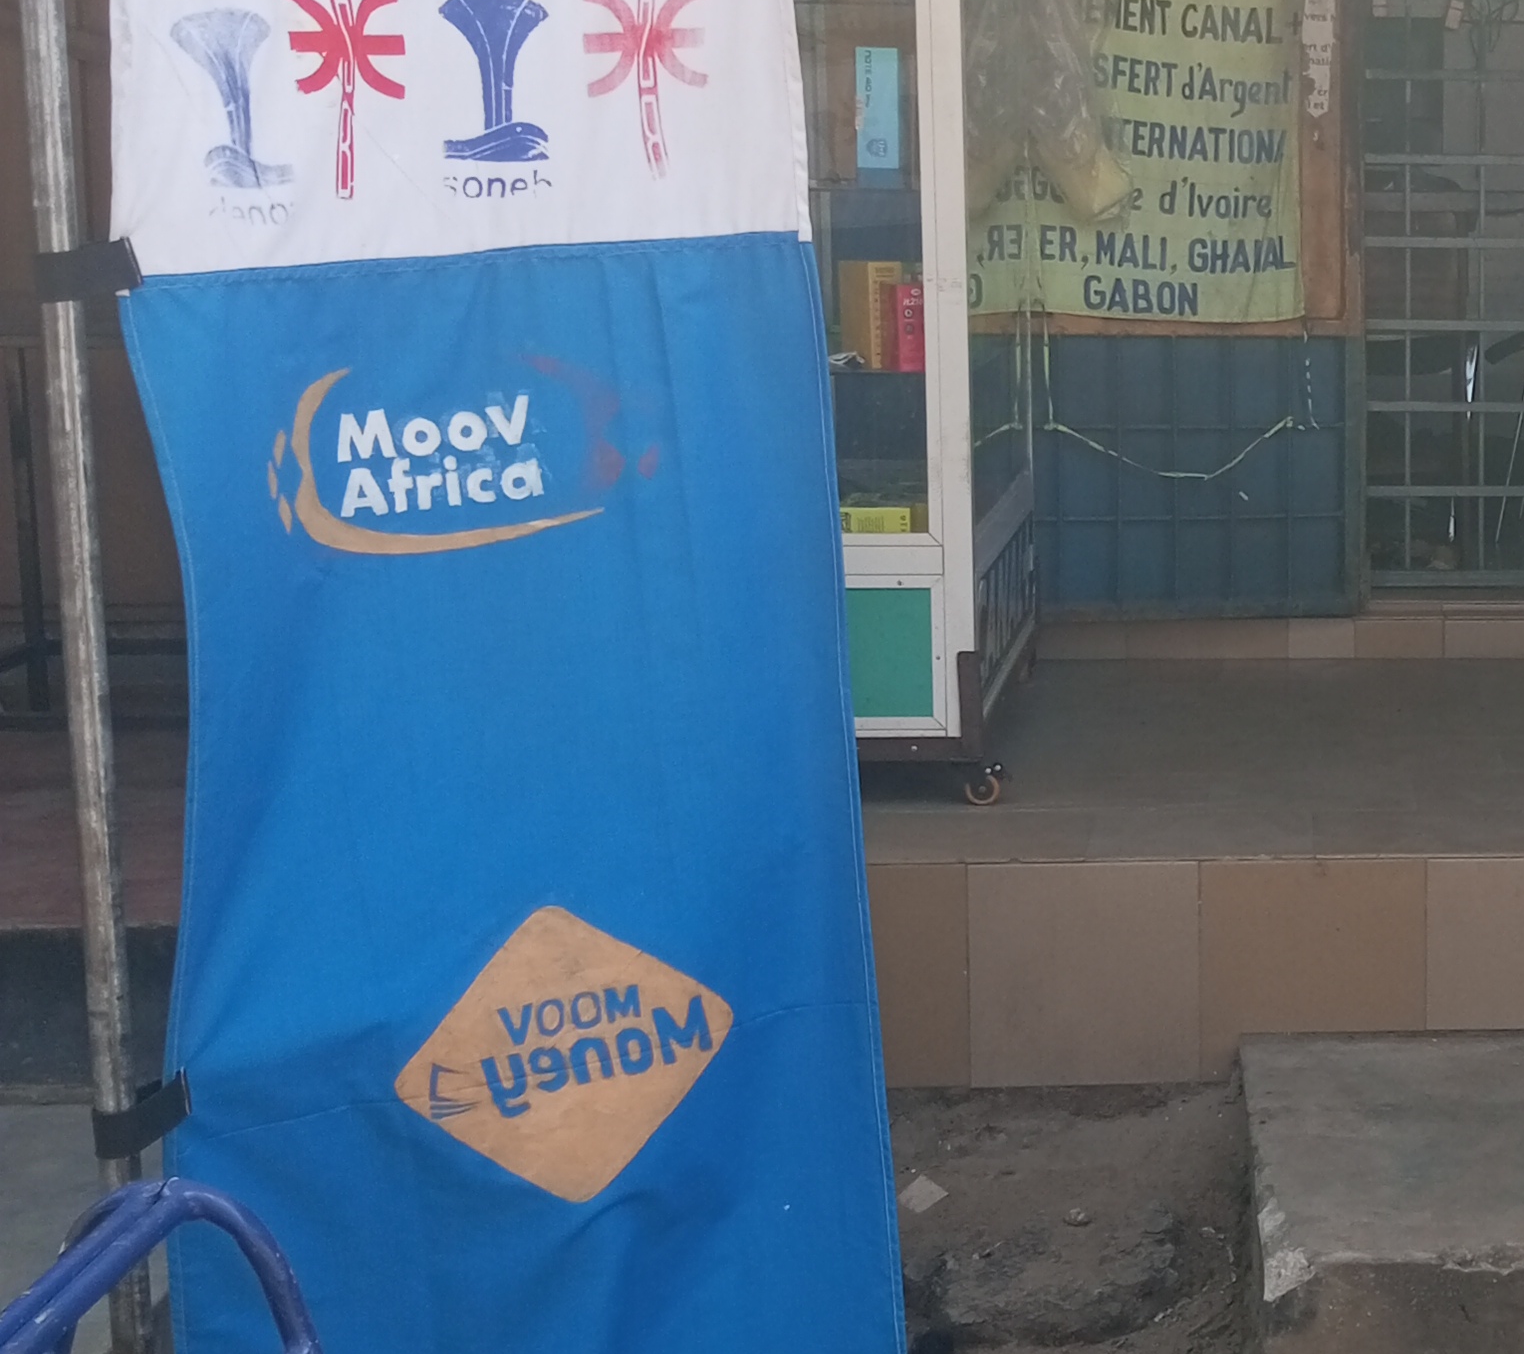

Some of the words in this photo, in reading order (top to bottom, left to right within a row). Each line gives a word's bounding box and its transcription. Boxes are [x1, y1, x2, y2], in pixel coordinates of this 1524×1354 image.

[1093, 52, 1179, 98] SFERT
[1181, 62, 1294, 119] d'Argent
[1158, 176, 1273, 220] d'Ivoire
[1039, 224, 1090, 270] ER,
[1095, 229, 1178, 275] MALI,
[1083, 274, 1199, 317] GABON
[335, 393, 530, 464] Moov
[340, 454, 545, 518] Africa
